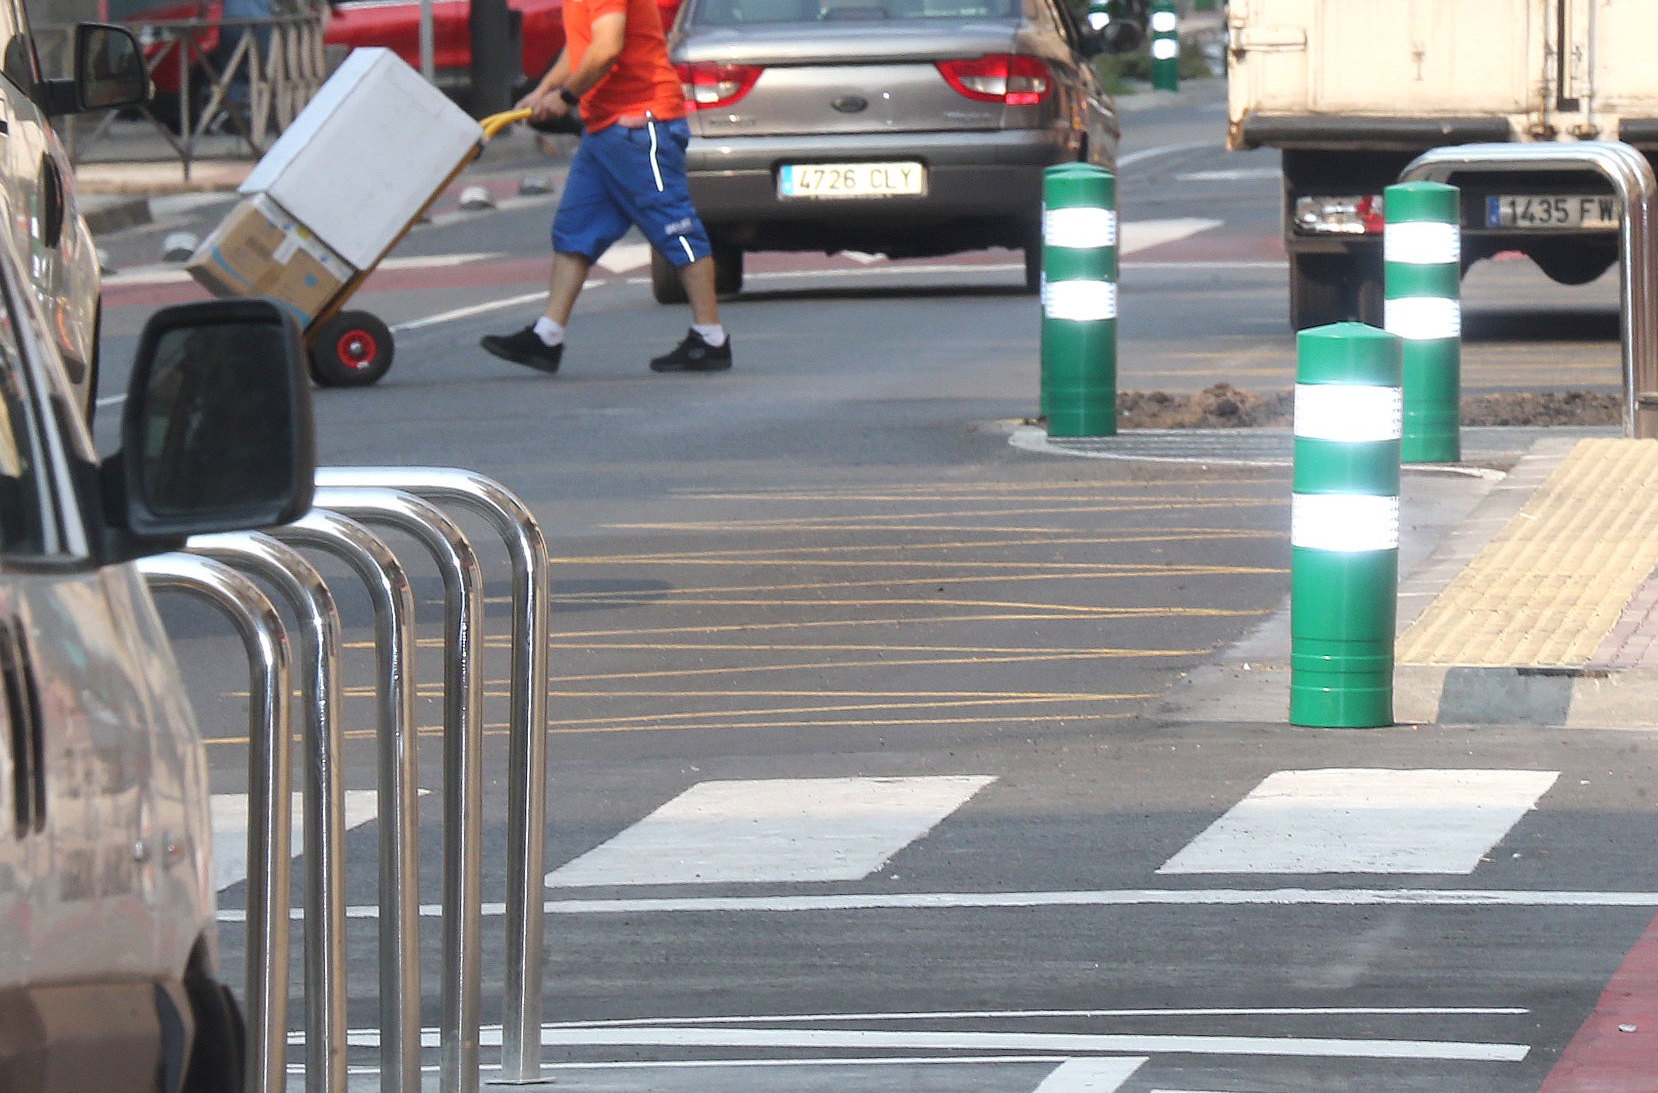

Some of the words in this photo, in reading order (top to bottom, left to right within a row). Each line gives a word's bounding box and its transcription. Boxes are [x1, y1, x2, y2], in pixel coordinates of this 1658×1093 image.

[799, 169, 856, 191] 4726
[870, 169, 913, 190] CLY
[1509, 198, 1570, 225] 1435
[1580, 198, 1616, 222] FW
